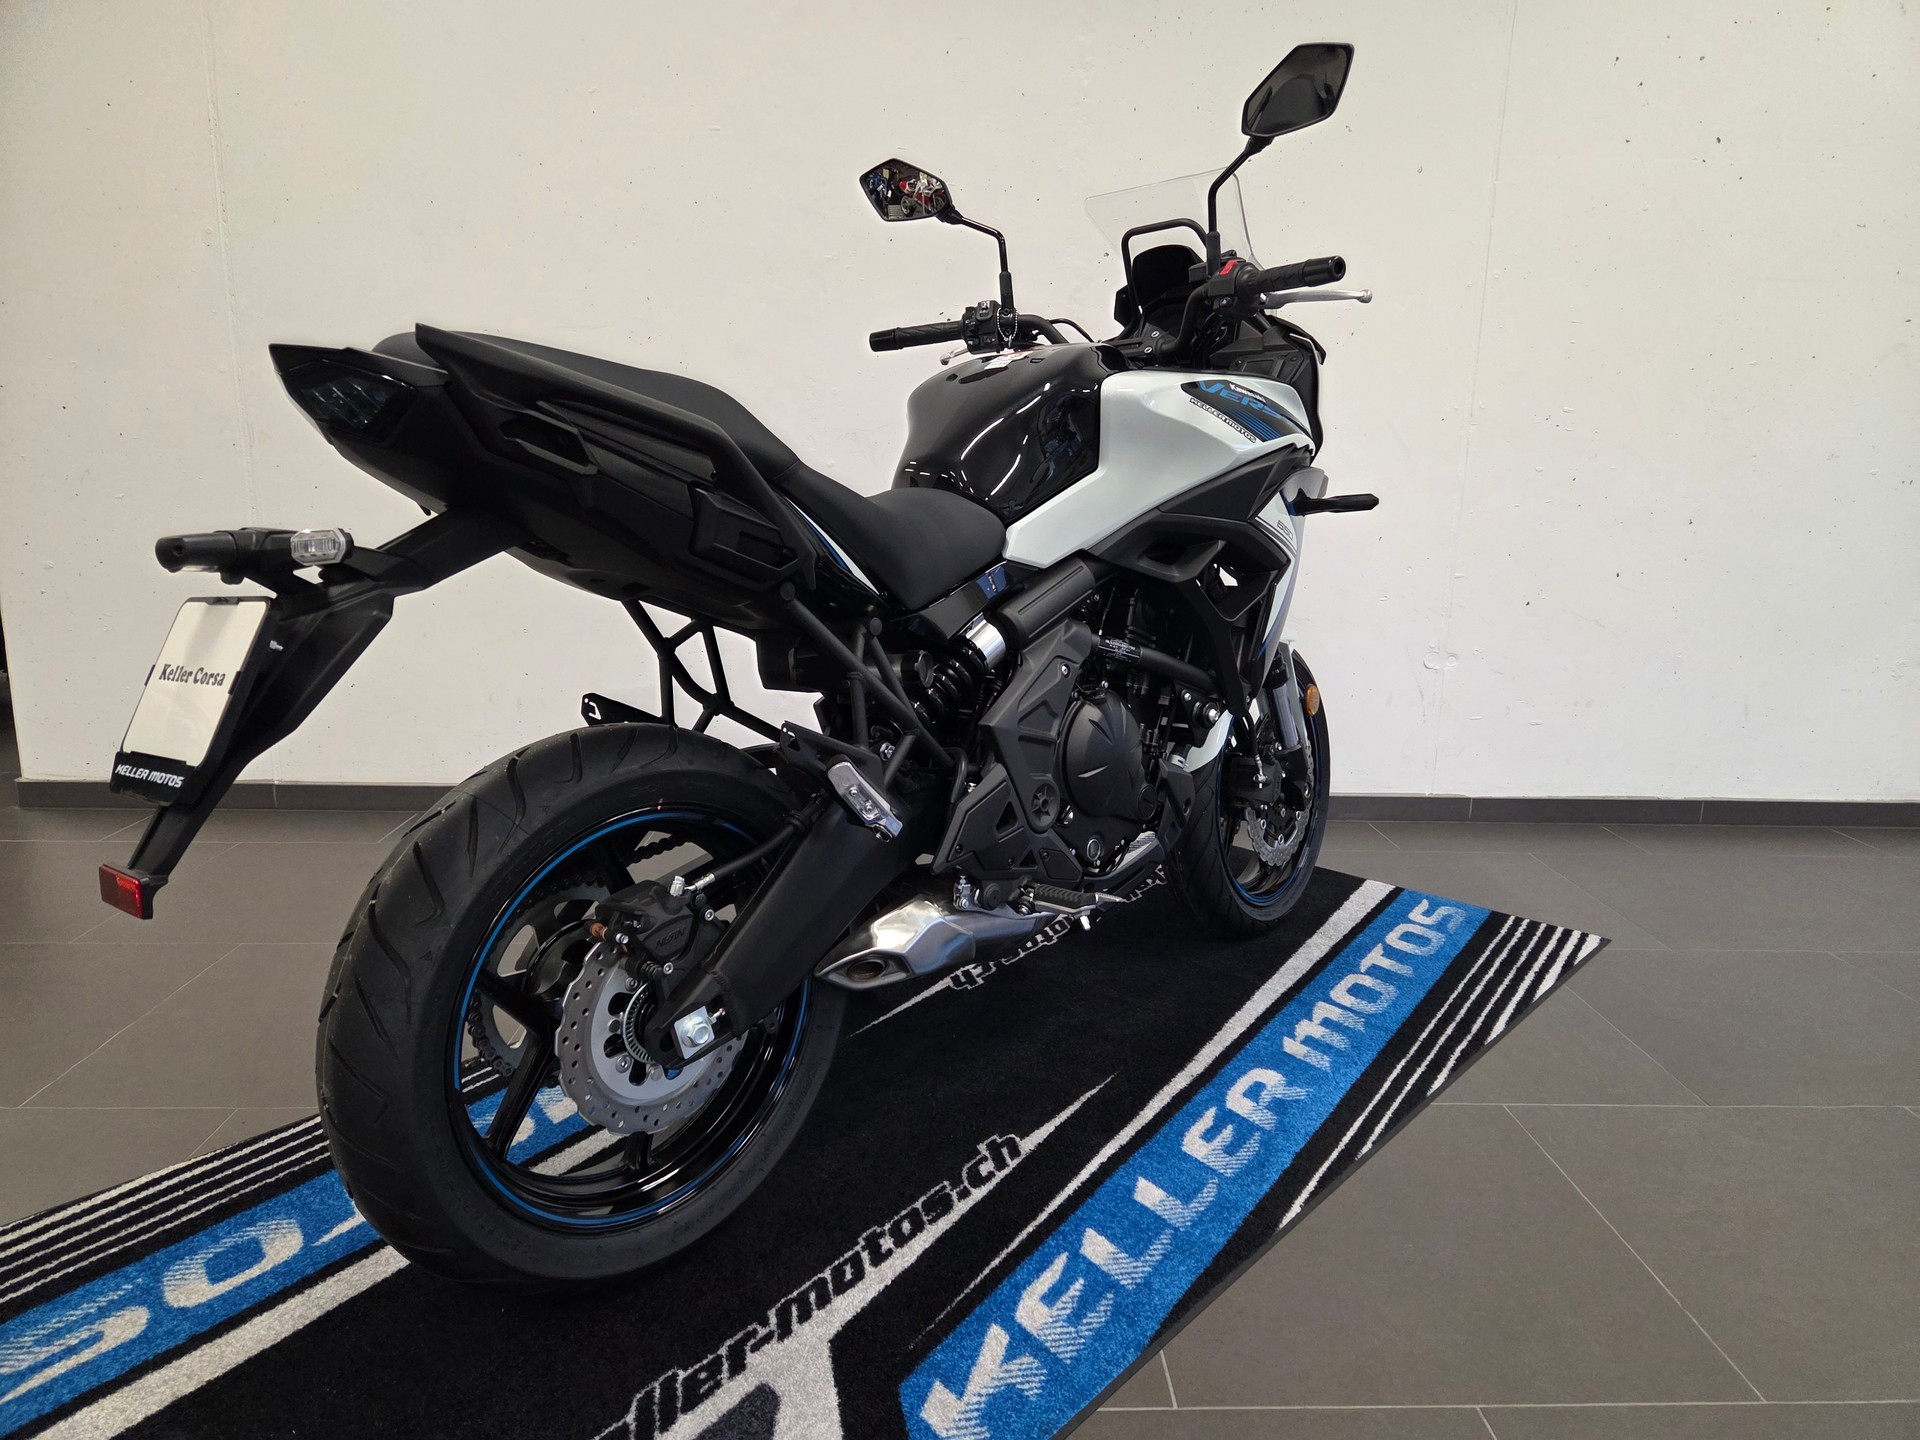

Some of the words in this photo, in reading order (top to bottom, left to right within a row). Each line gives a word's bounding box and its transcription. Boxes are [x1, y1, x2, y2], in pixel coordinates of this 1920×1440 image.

[1189, 397, 1226, 423] KELLER
[1225, 418, 1257, 444] MOTOS
[159, 663, 193, 683] Keller
[193, 667, 226, 687] Corsa
[114, 764, 149, 780] KELLER
[147, 771, 185, 788] MOTOS
[919, 1067, 1314, 1440] KELLER
[1283, 898, 1467, 1074] MOTOS
